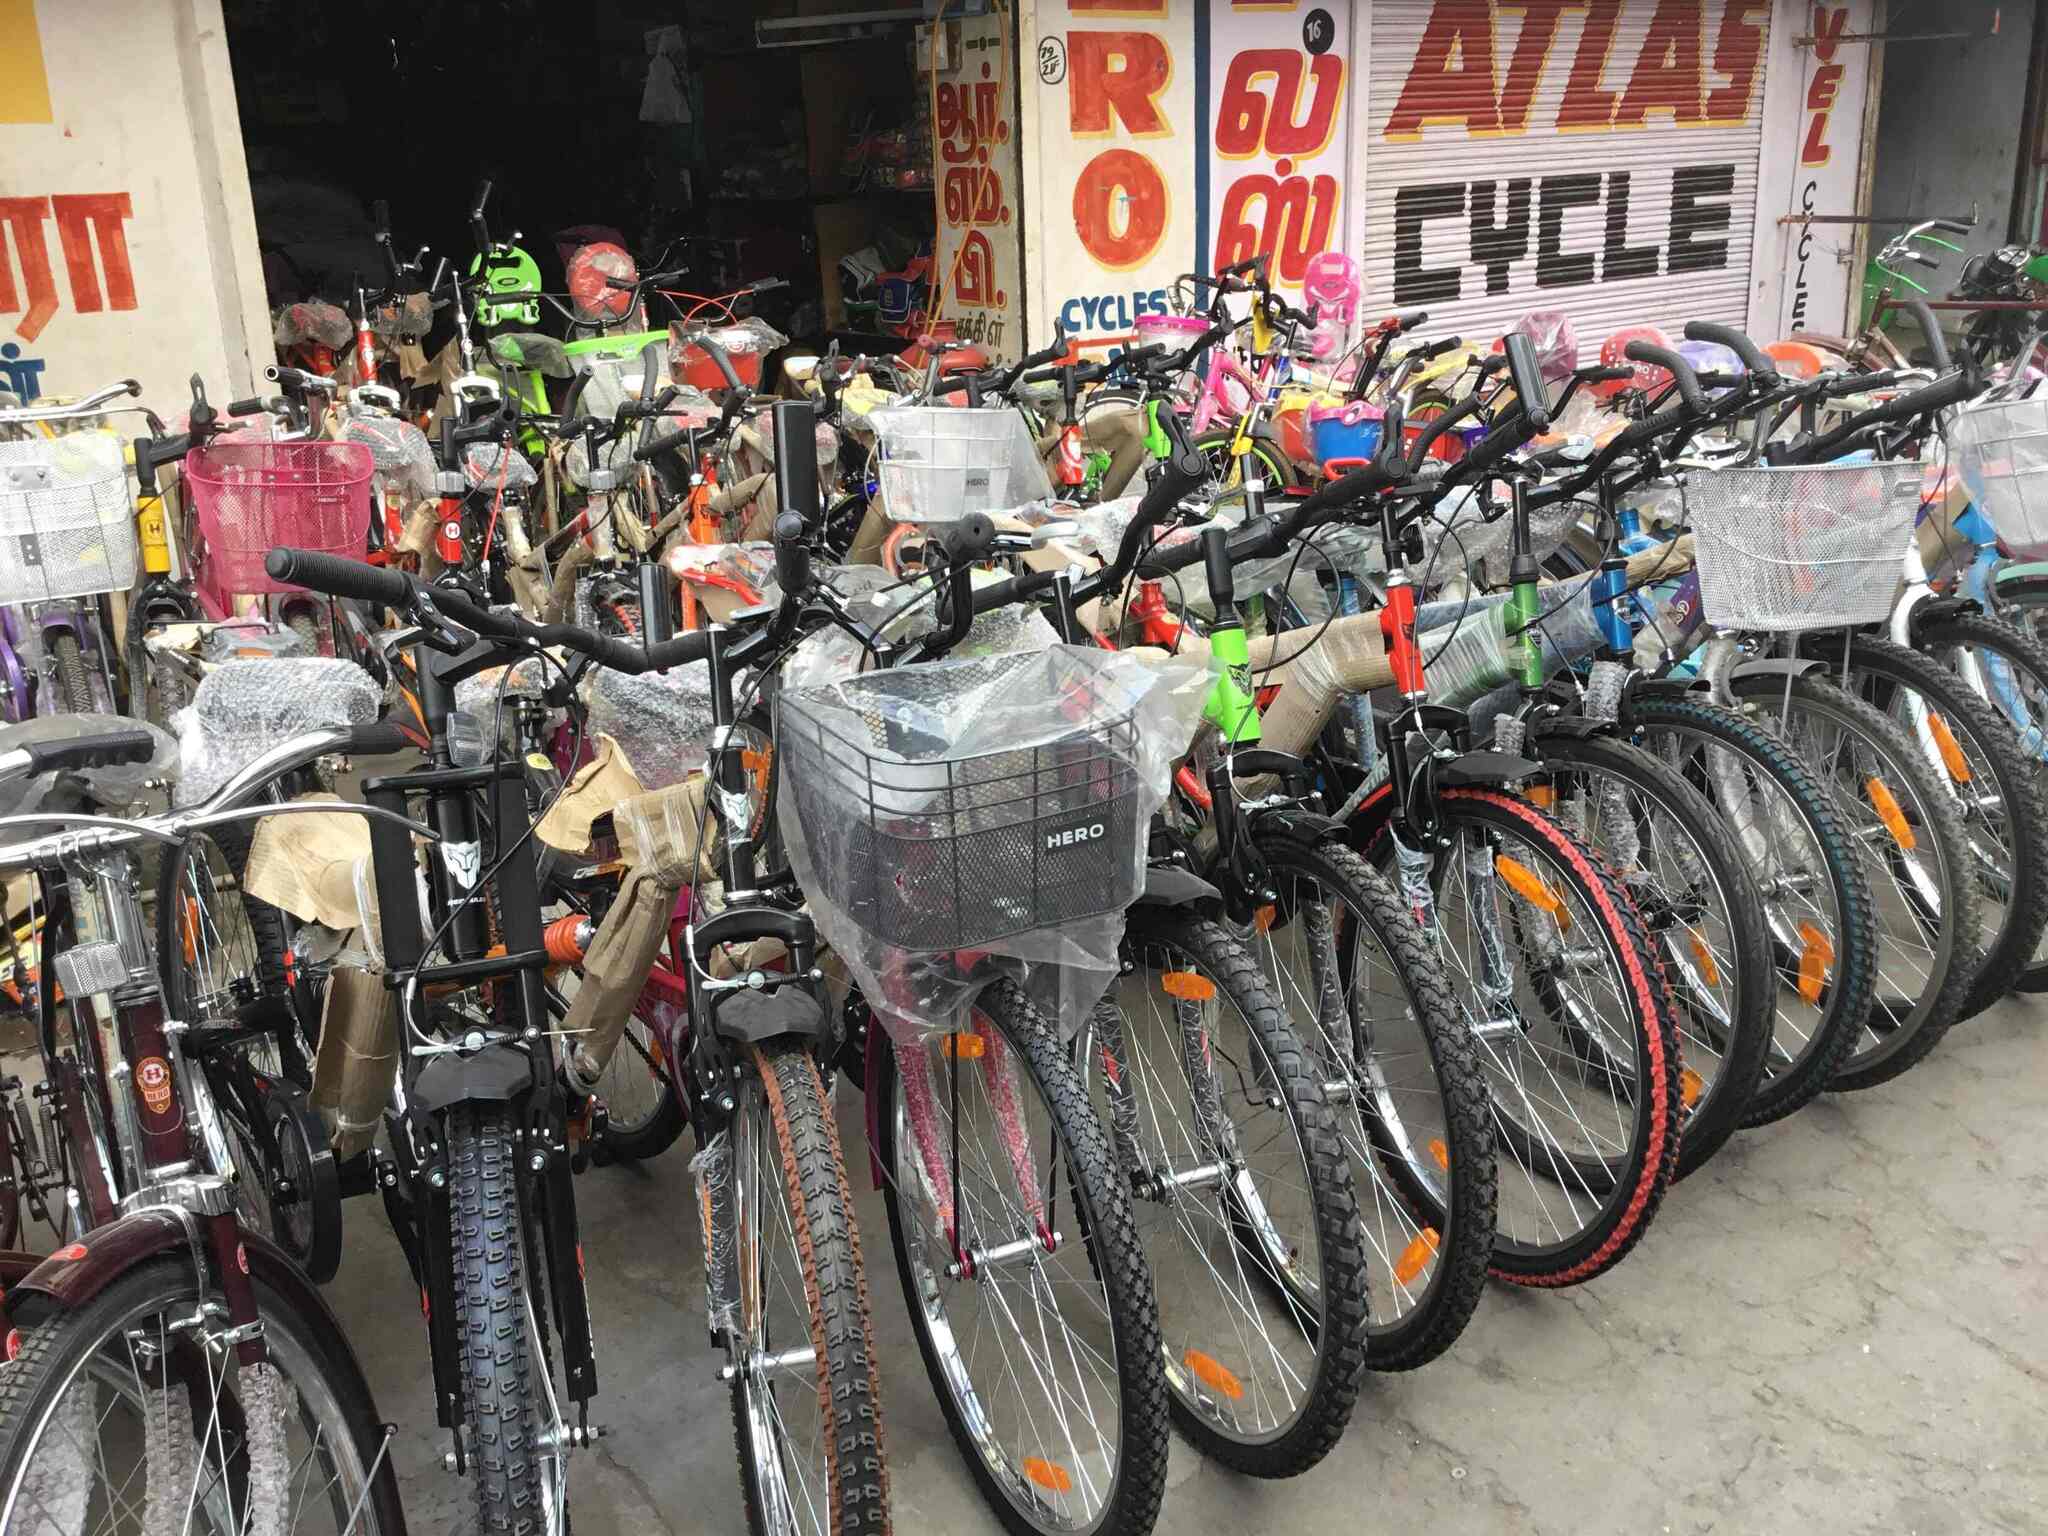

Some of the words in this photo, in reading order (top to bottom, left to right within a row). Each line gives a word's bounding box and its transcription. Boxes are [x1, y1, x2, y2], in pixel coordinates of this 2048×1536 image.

[1306, 19, 1321, 42] 16
[1383, 0, 1772, 142] ATLAS
[1801, 6, 1849, 168] VEL
[1393, 164, 1735, 306] CYCLE
[1047, 823, 1105, 848] HERO
